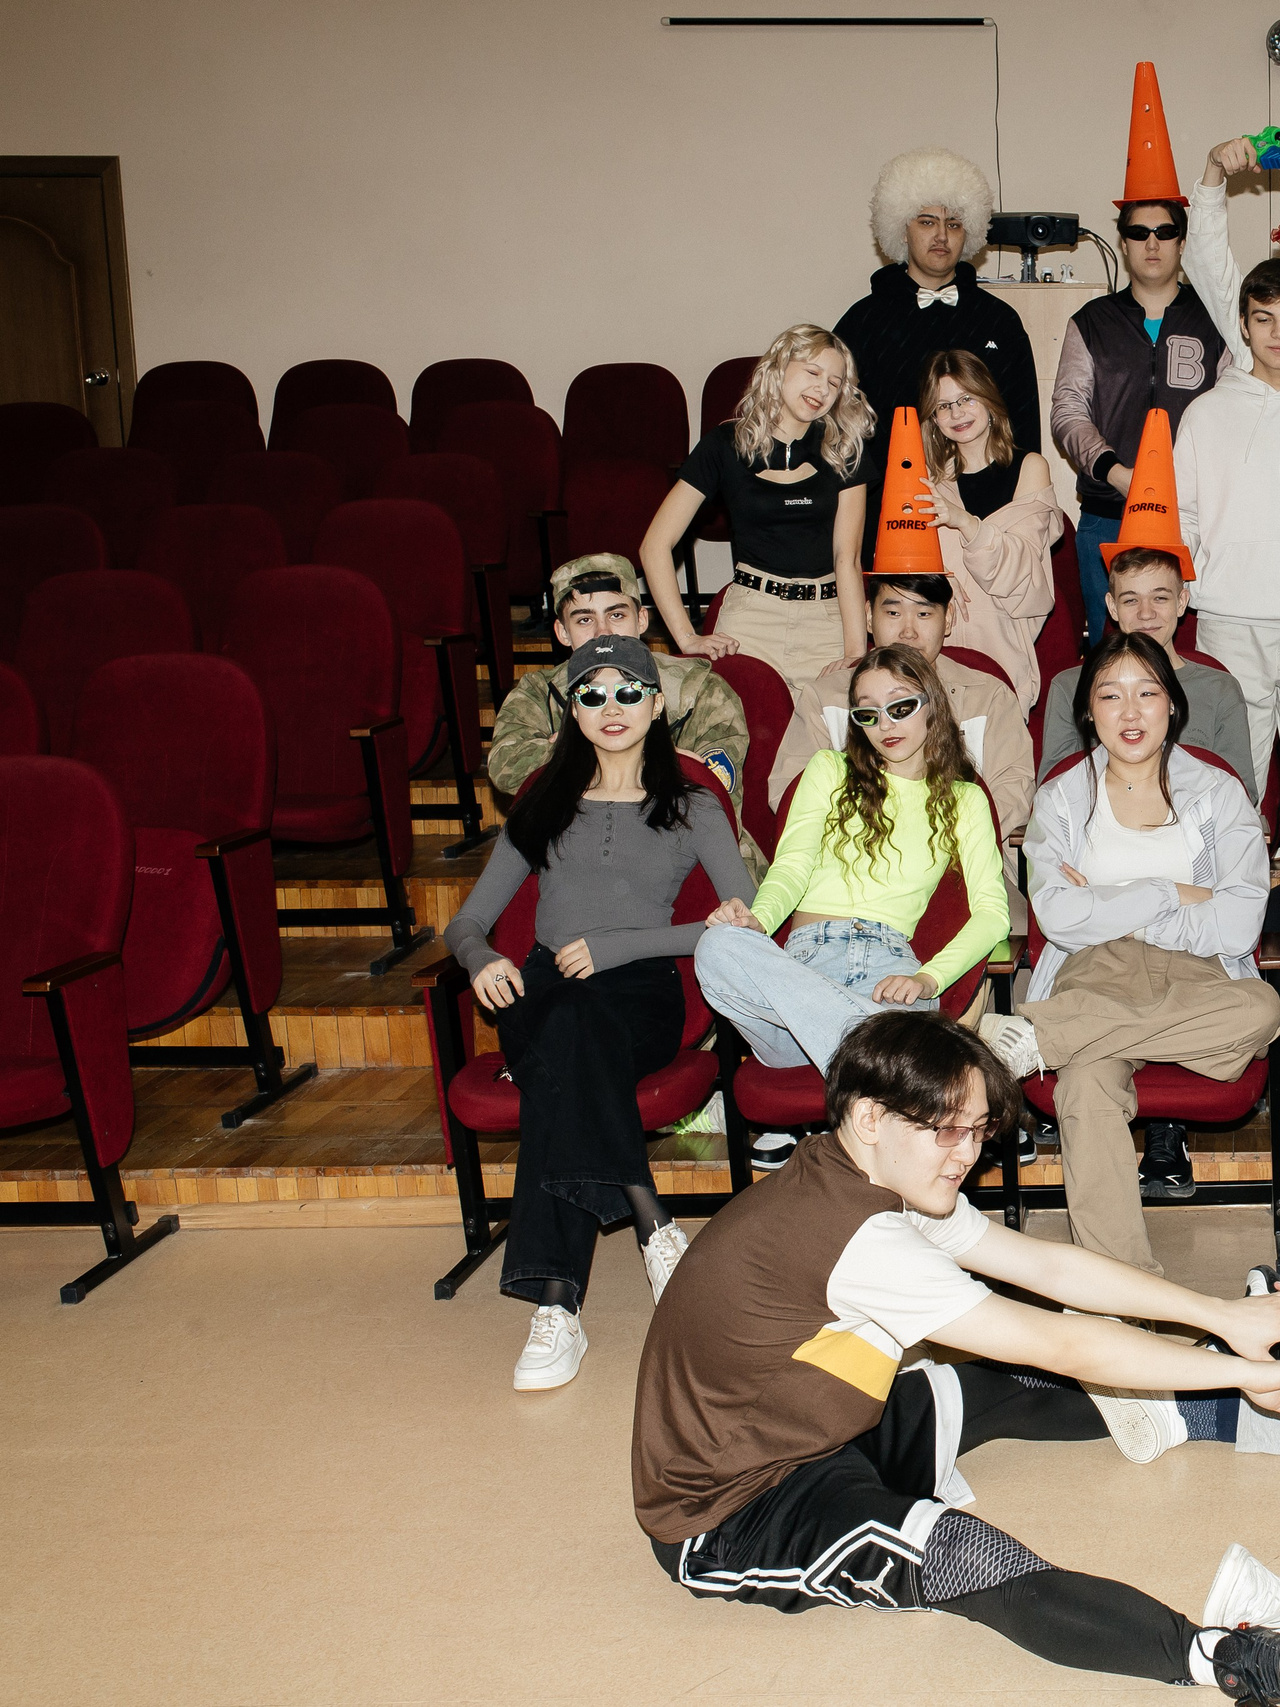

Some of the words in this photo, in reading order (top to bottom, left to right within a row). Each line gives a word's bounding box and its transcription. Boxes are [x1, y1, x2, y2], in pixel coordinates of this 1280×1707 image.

[1166, 335, 1206, 390] B
[1128, 502, 1169, 514] TORRES
[886, 519, 927, 531] TORRES
